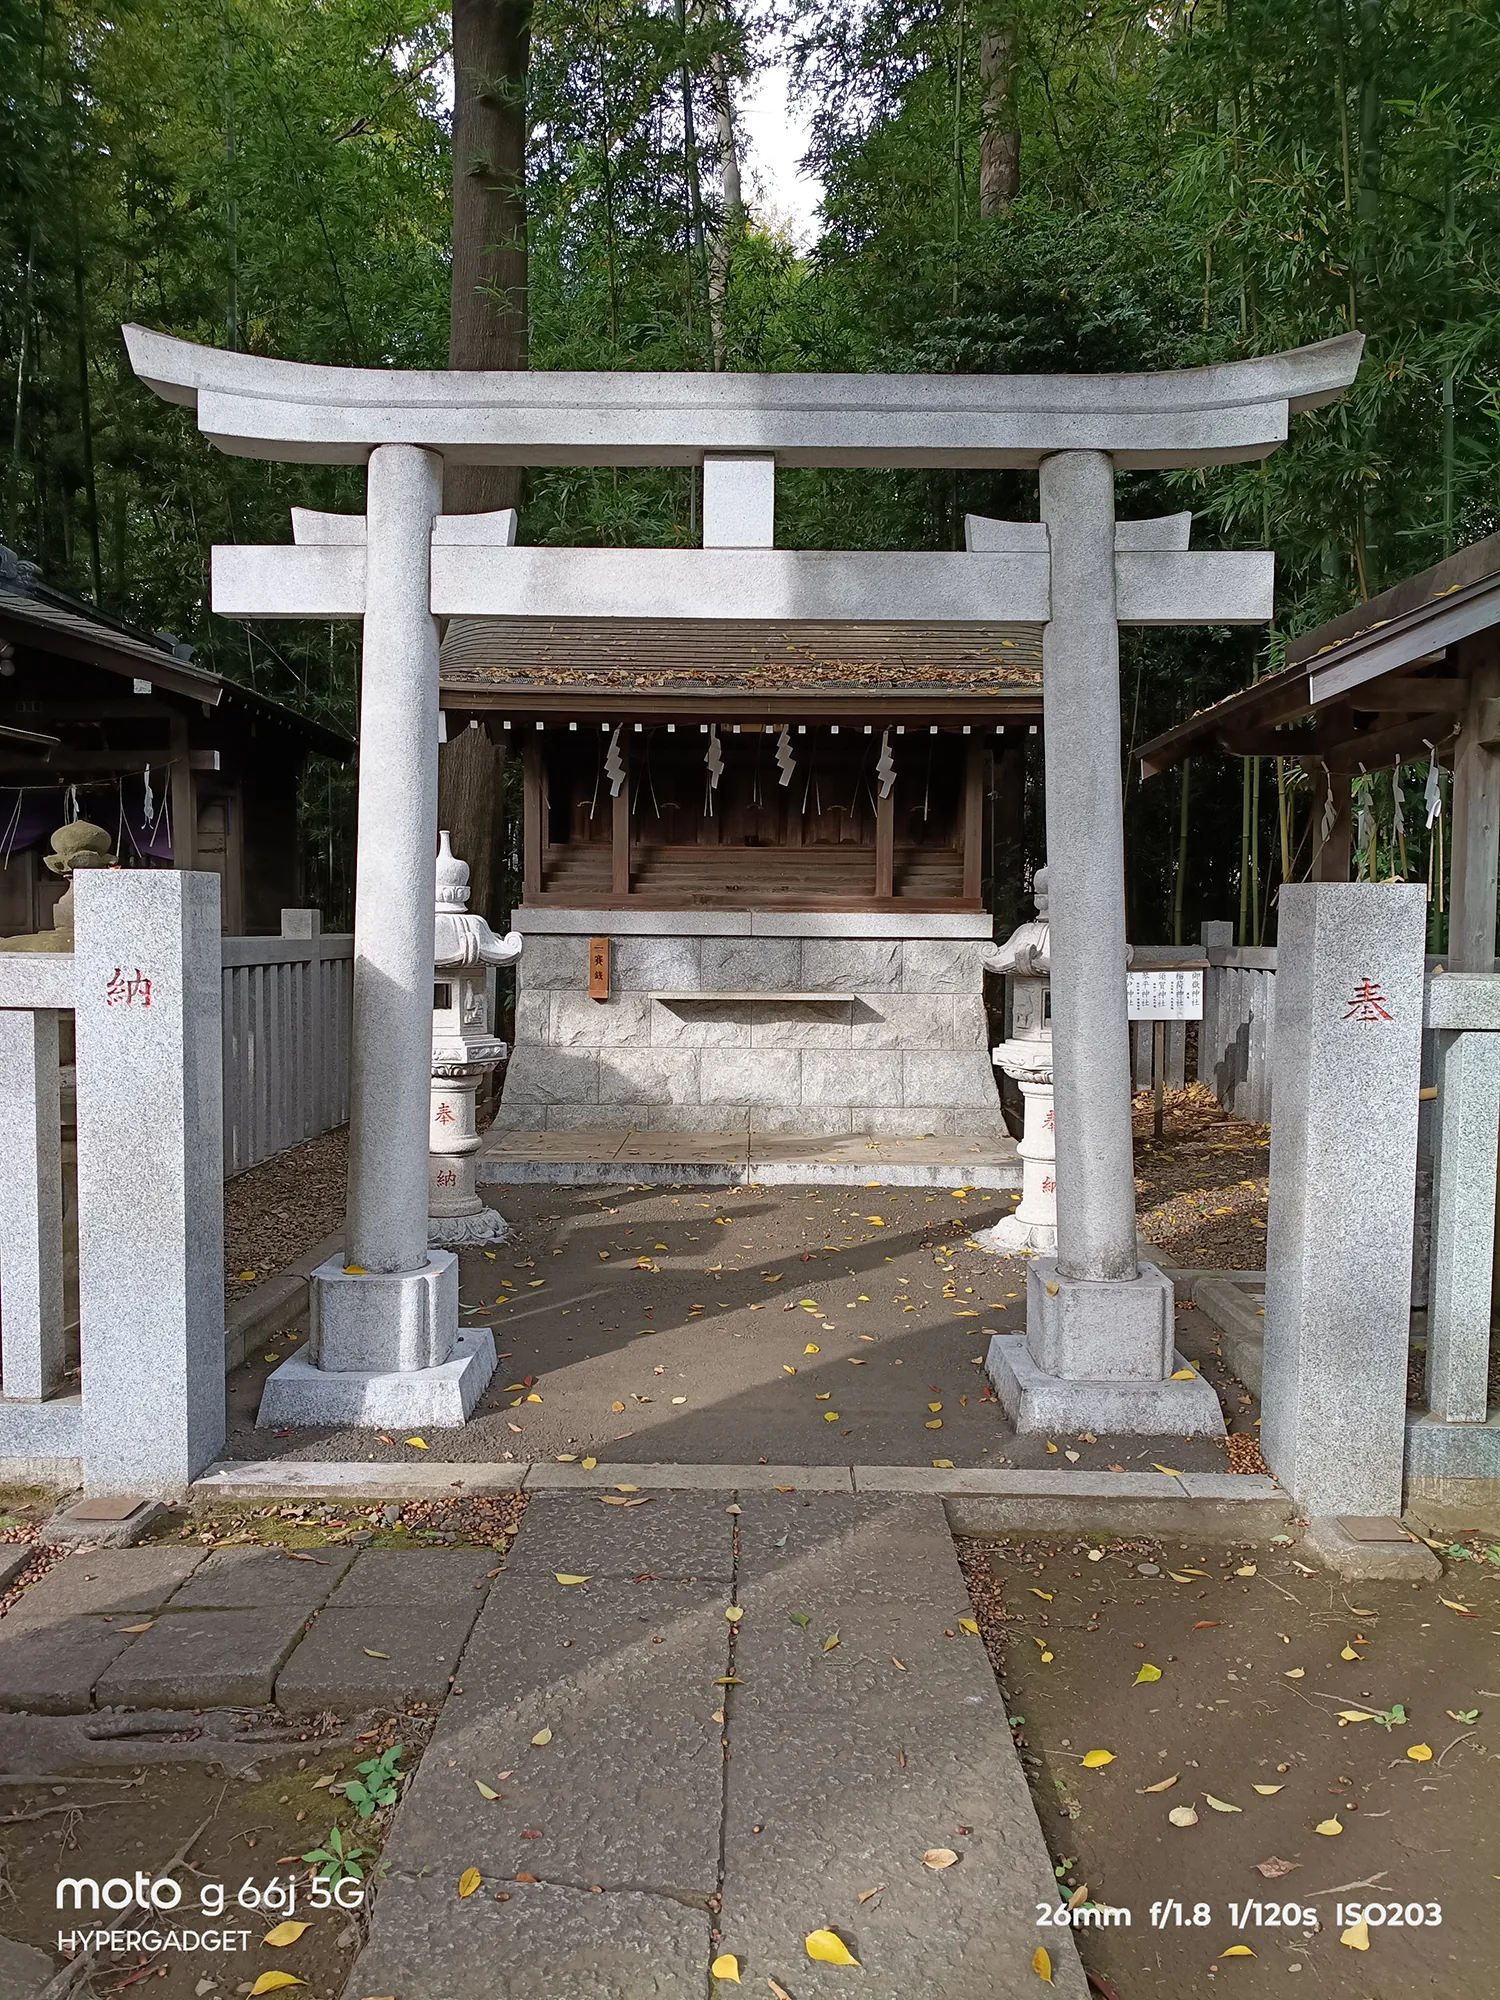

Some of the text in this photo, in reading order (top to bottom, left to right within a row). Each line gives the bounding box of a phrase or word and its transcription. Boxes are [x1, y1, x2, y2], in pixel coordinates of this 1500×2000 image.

[106, 968, 152, 1008] 納
[1341, 977, 1393, 1028] 奉
[434, 1102, 456, 1126] 奉
[436, 1169, 457, 1187] 納
